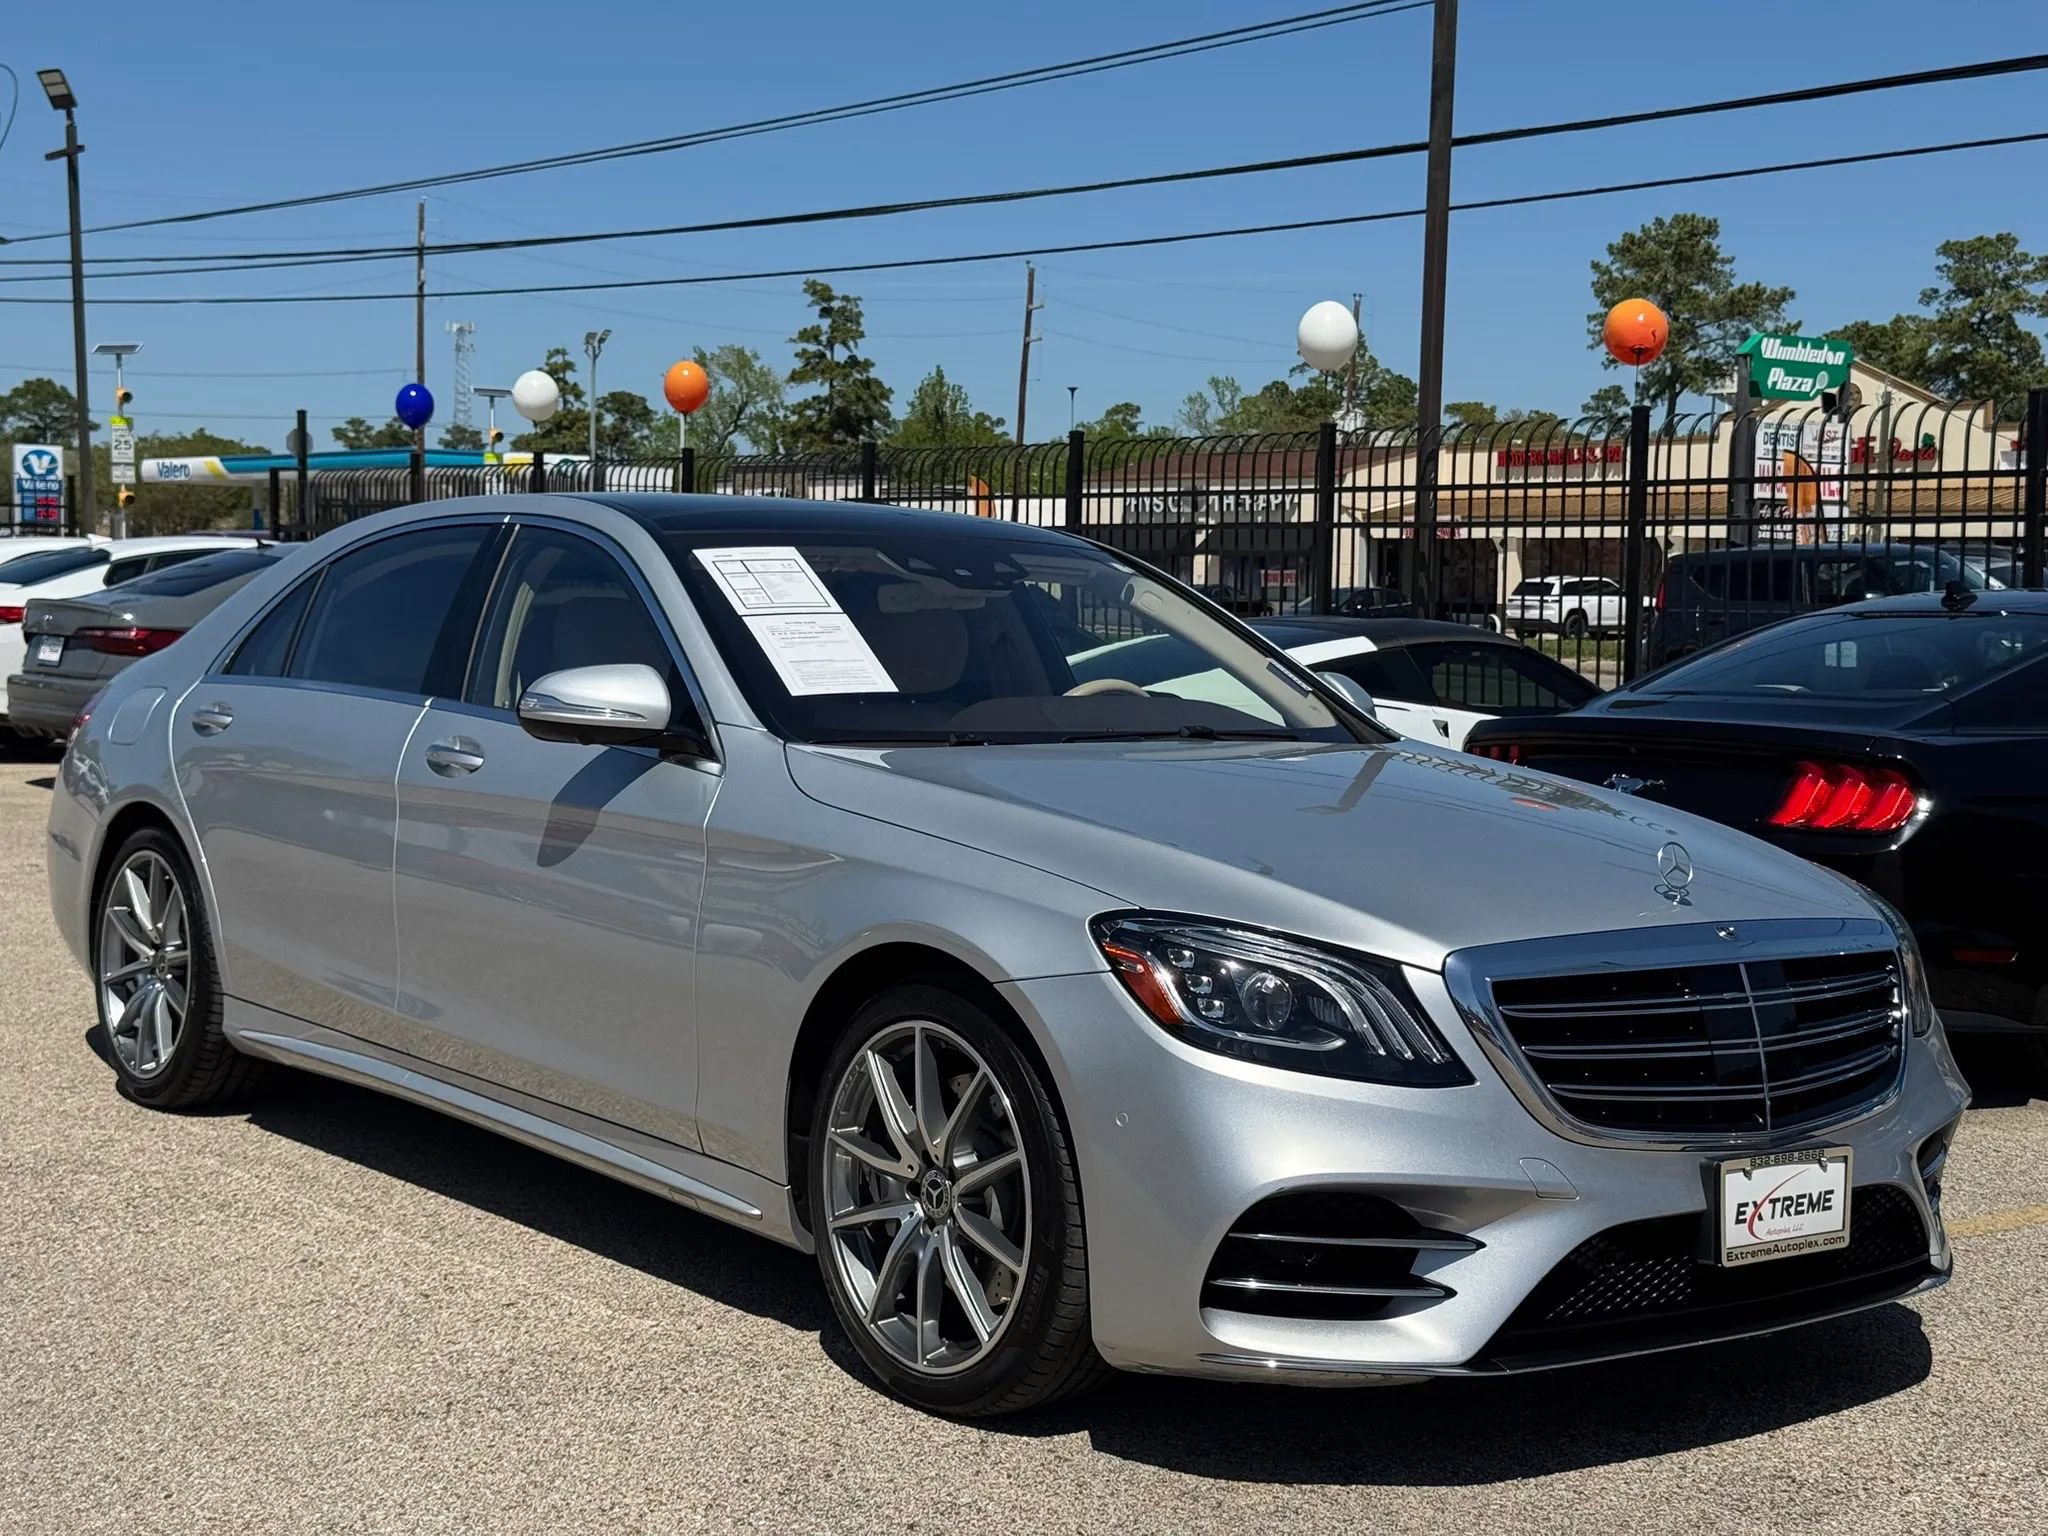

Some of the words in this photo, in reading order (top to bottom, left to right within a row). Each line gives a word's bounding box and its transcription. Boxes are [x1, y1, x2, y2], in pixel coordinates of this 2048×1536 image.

[1761, 337, 1845, 366] Wimbledon
[1767, 367, 1814, 393] Plaza
[113, 439, 132, 451] 25
[1603, 445, 1623, 462] PA
[157, 461, 191, 479] Valero
[22, 480, 59, 491] Valero
[1734, 1189, 1835, 1226] EXTREME
[1726, 1235, 1846, 1262] ExtremeAutoplex.com
